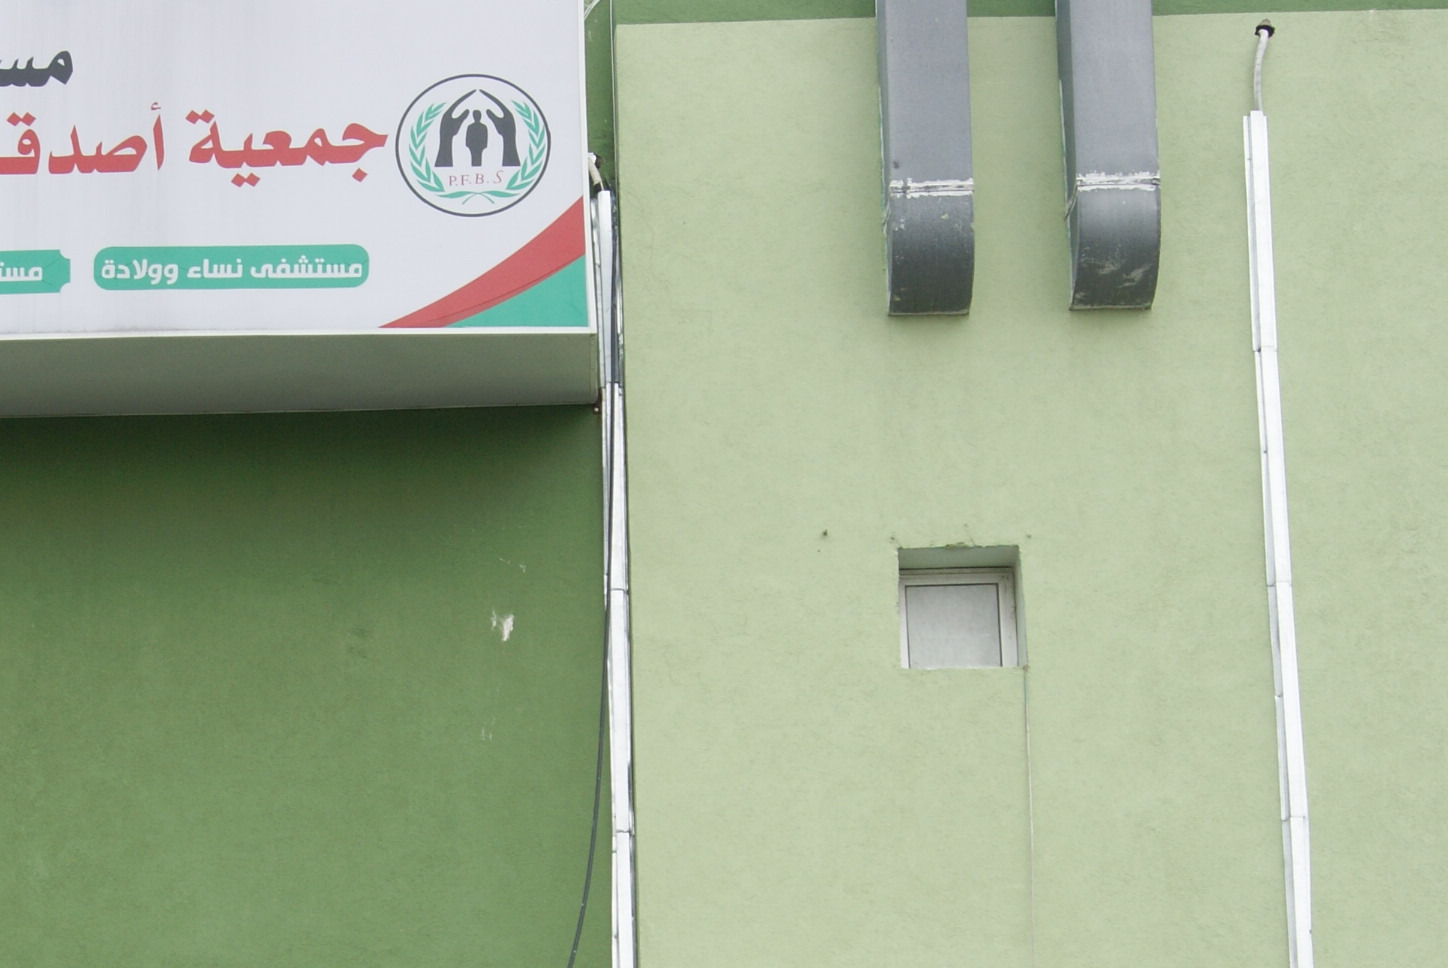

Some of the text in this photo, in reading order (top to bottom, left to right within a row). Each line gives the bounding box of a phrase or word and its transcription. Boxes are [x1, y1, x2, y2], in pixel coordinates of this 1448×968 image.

[186, 111, 388, 187] جمعية
[101, 255, 363, 285] مستشفى نساء وولادة
